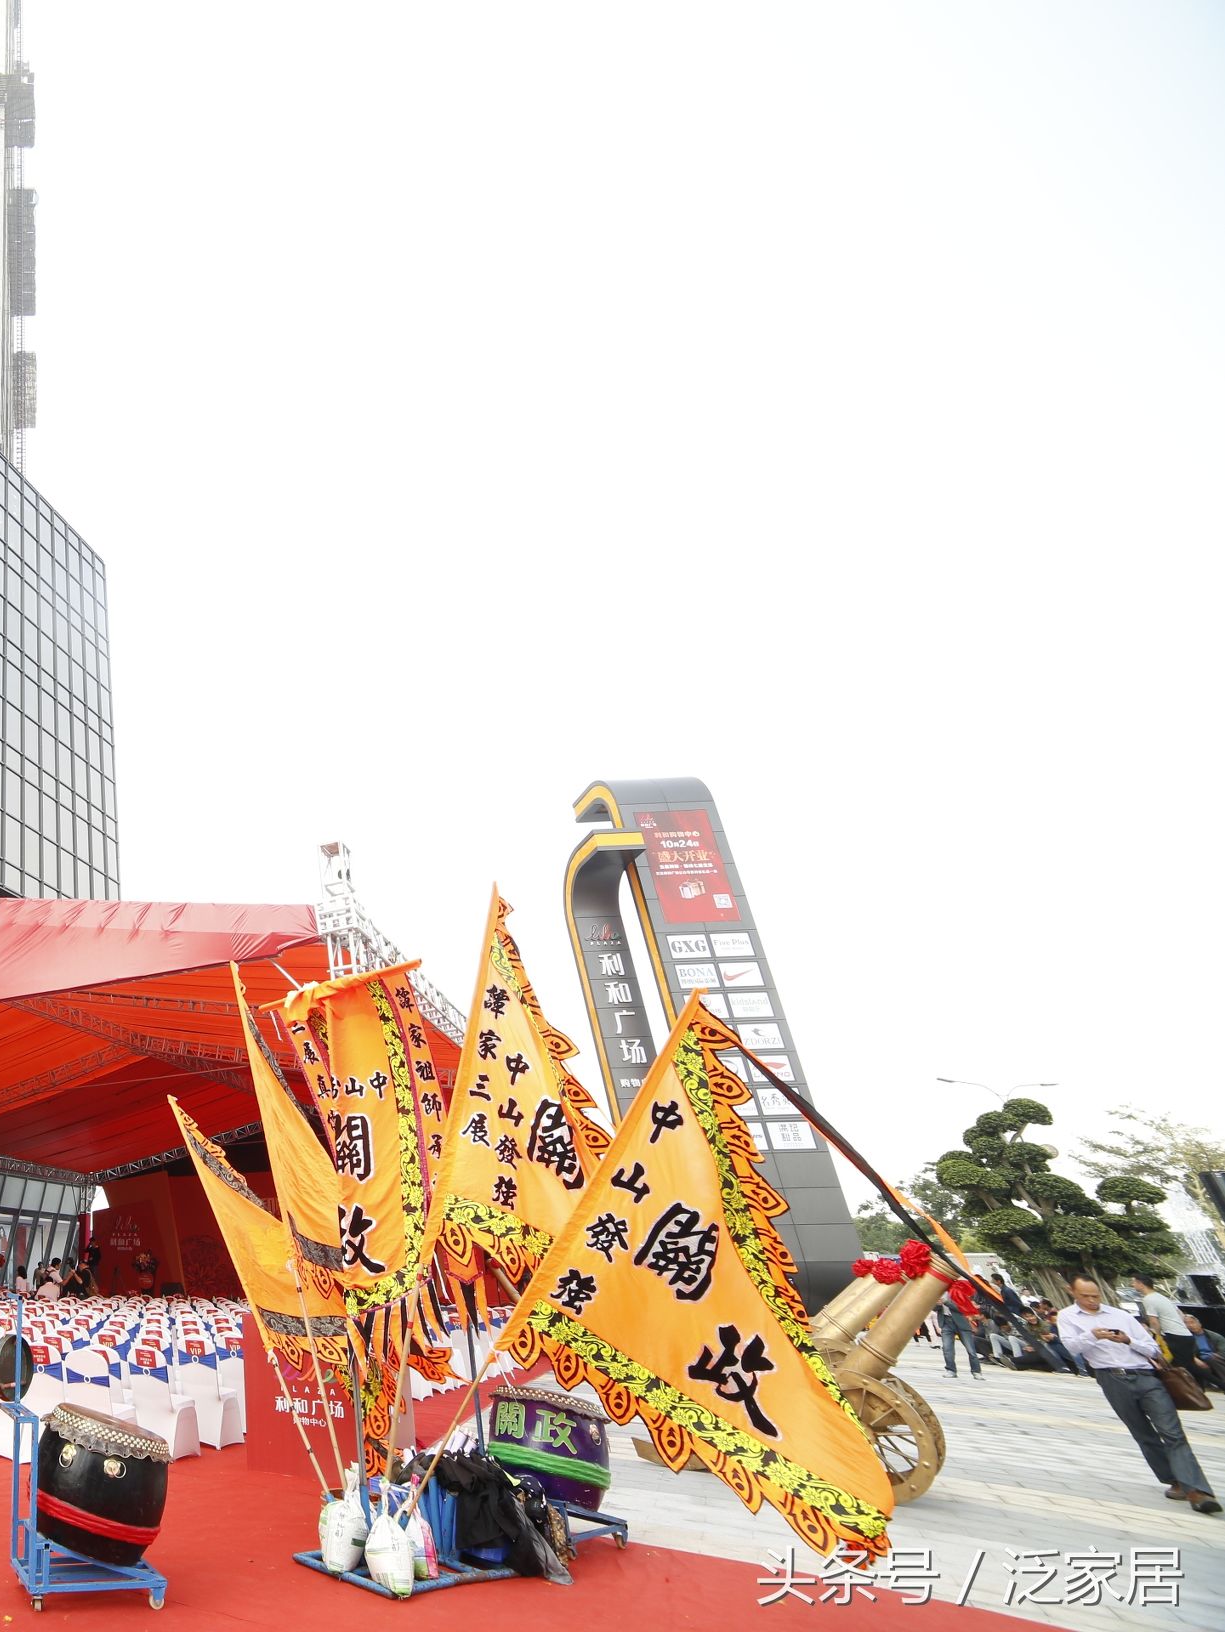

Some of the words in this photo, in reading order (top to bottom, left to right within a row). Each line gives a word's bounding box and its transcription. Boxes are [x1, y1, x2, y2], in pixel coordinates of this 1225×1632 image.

[657, 850, 710, 863] 盛大开业
[670, 939, 707, 954] GXG
[678, 967, 714, 978] BONA
[597, 952, 648, 1064] 利和广场
[619, 1077, 647, 1089] 购物
[189, 1347, 202, 1355] VIP
[274, 1395, 345, 1419] 利和广场
